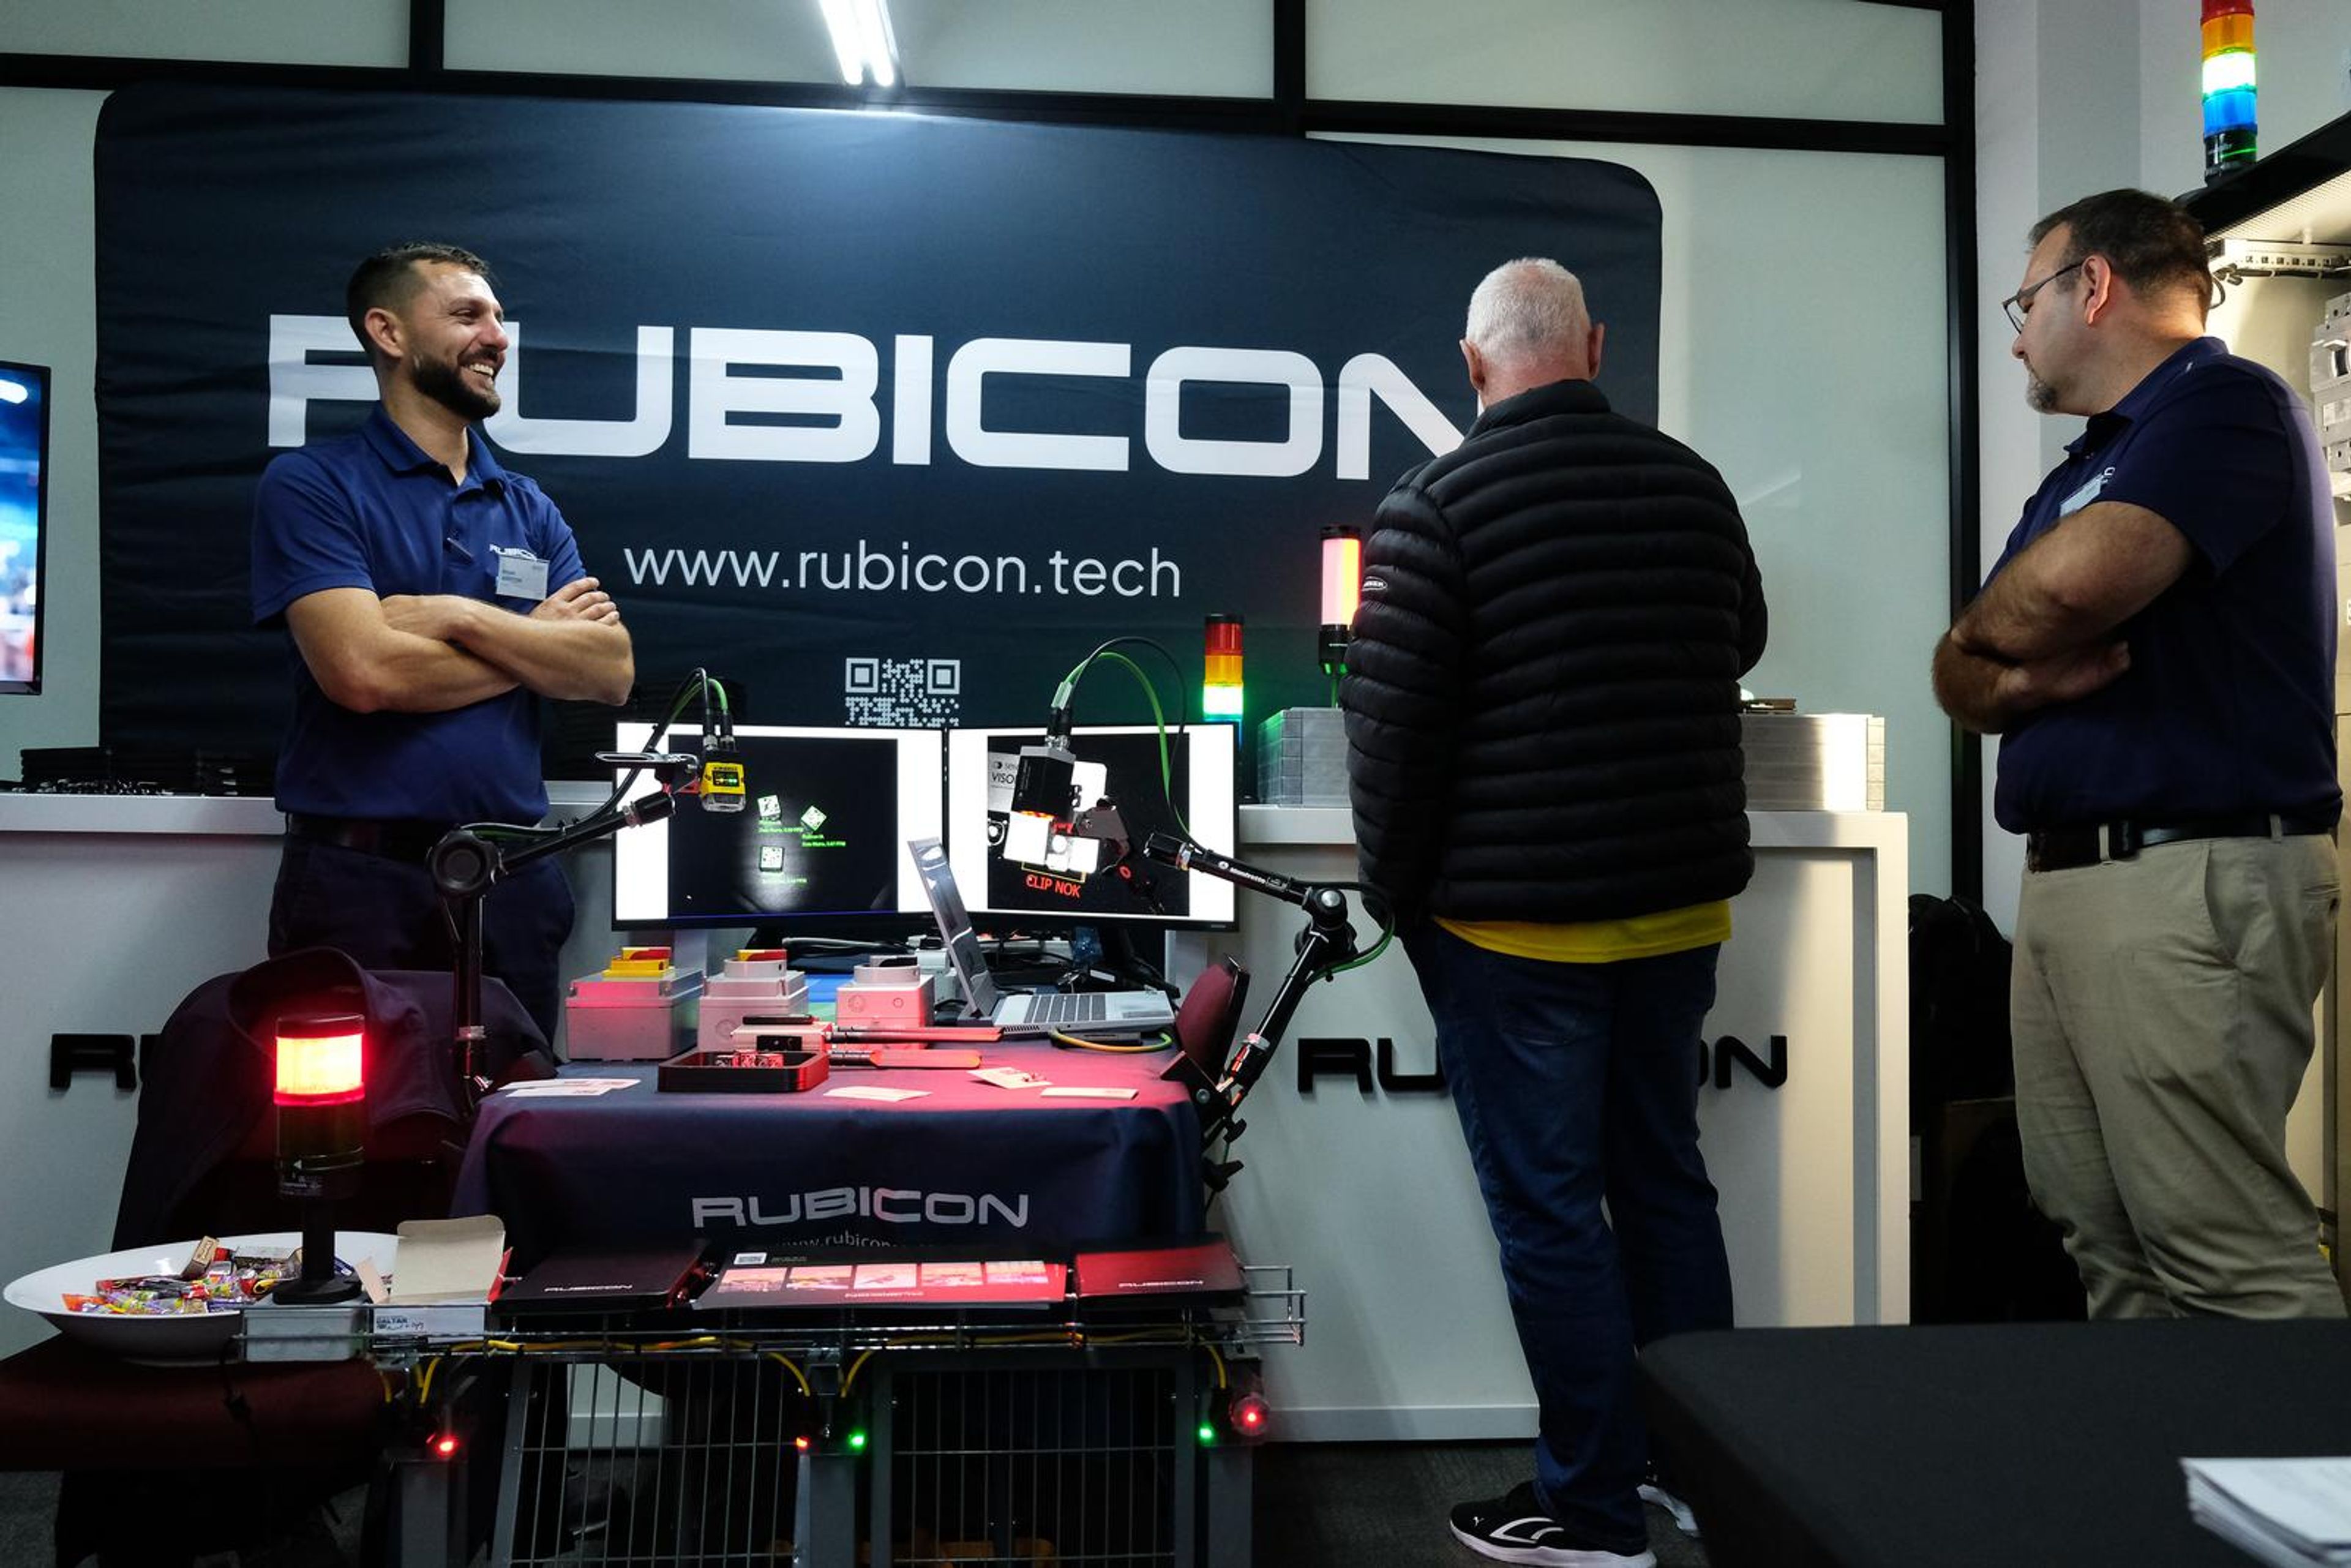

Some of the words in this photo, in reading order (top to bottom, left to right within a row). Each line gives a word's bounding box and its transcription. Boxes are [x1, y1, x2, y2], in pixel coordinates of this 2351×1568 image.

[623, 539, 1181, 598] www.rubicon.tech
[1026, 874, 1053, 890] CLIP
[1055, 880, 1082, 898] NOK
[691, 1186, 1029, 1228] RUBICON
